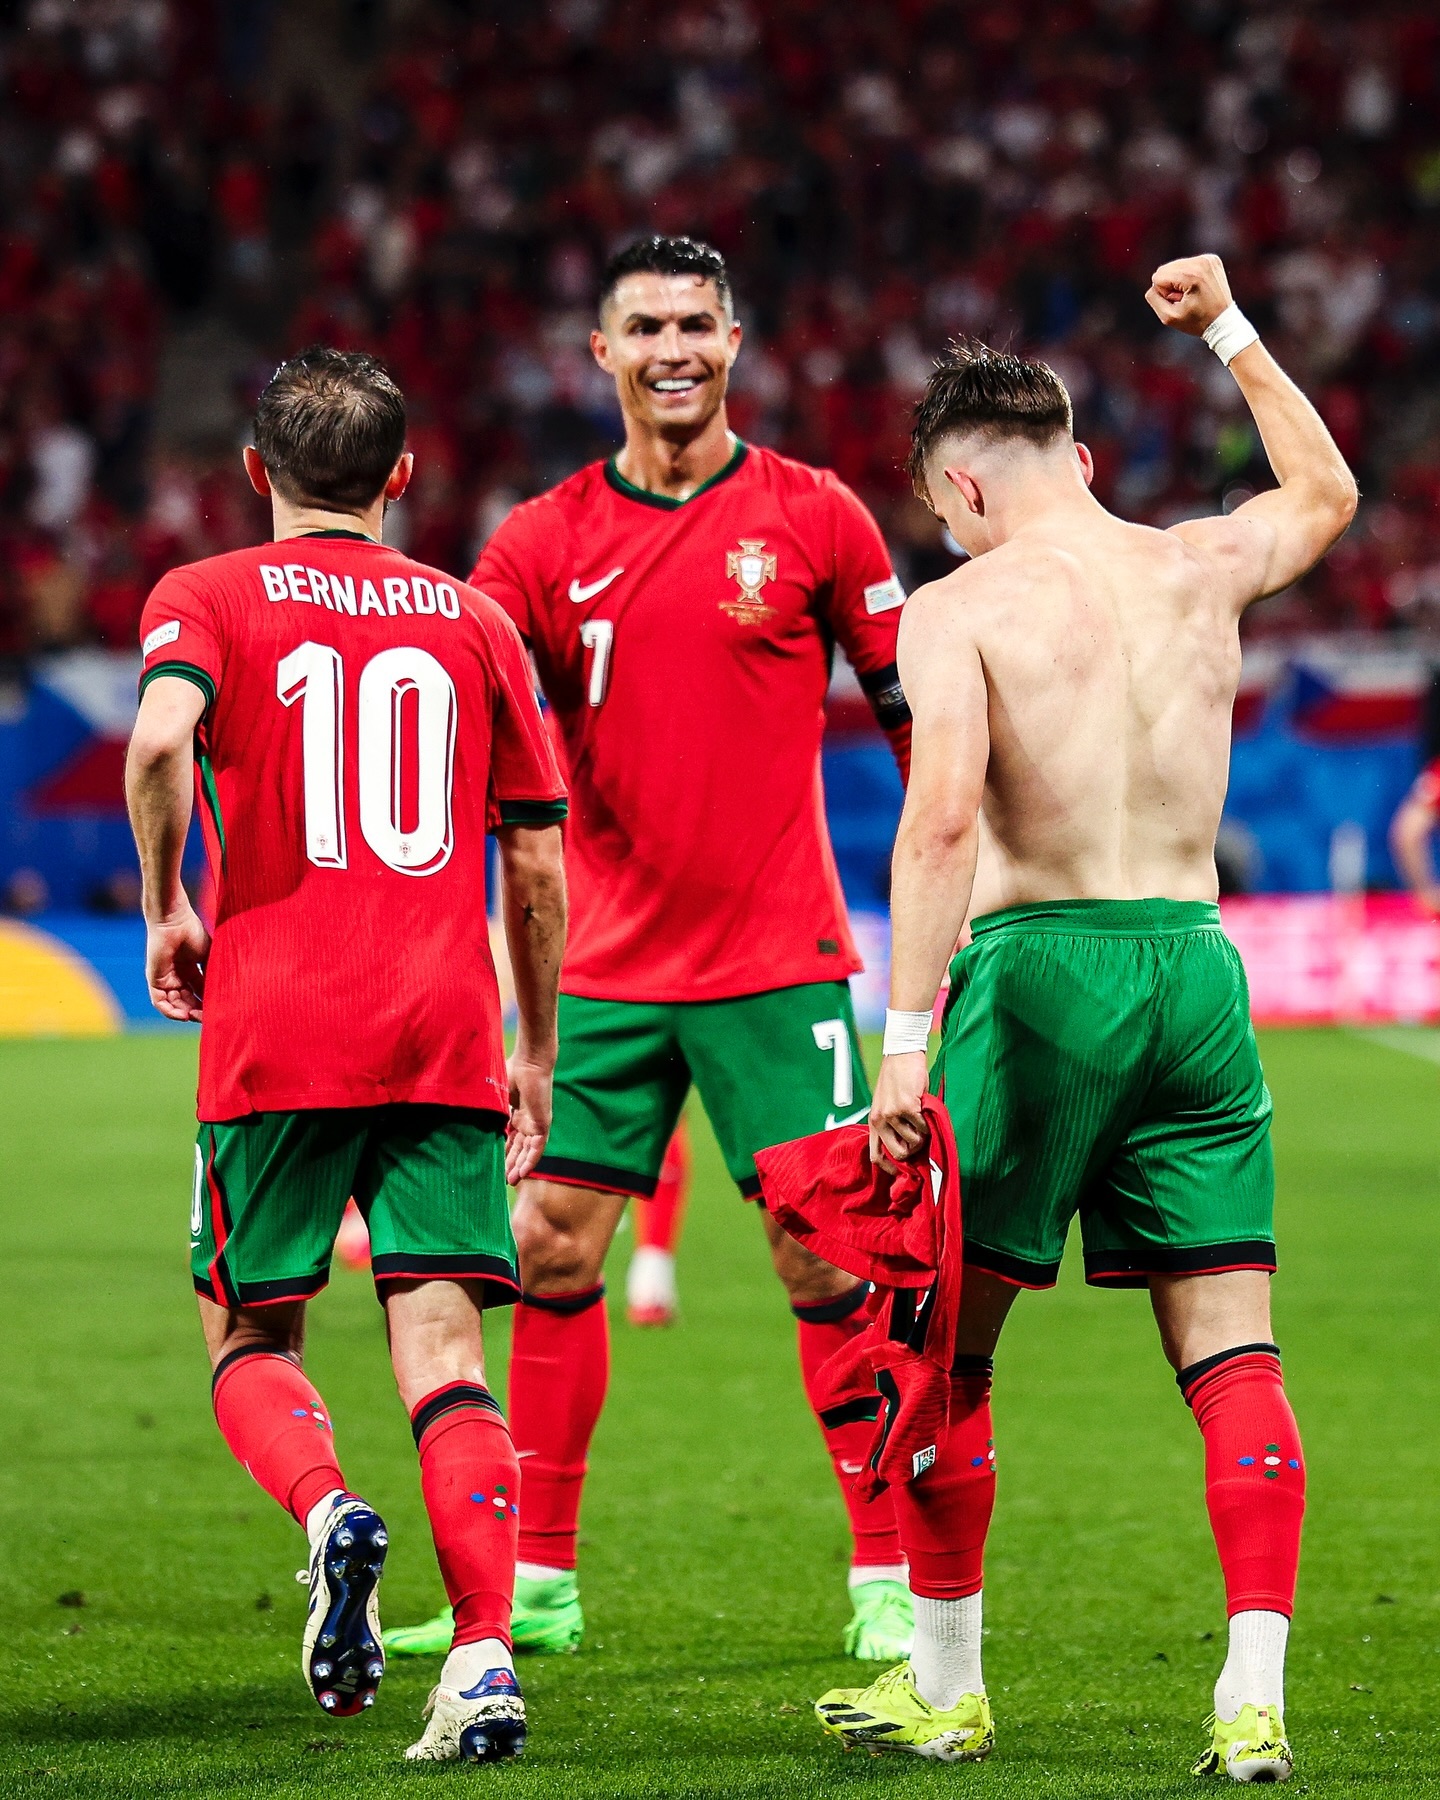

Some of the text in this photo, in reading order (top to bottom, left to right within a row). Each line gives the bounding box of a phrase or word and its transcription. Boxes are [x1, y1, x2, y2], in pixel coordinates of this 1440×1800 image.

[258, 563, 462, 620] BERNARDO
[579, 618, 614, 707] 7
[276, 640, 458, 877] 10
[811, 1018, 853, 1107] 7
